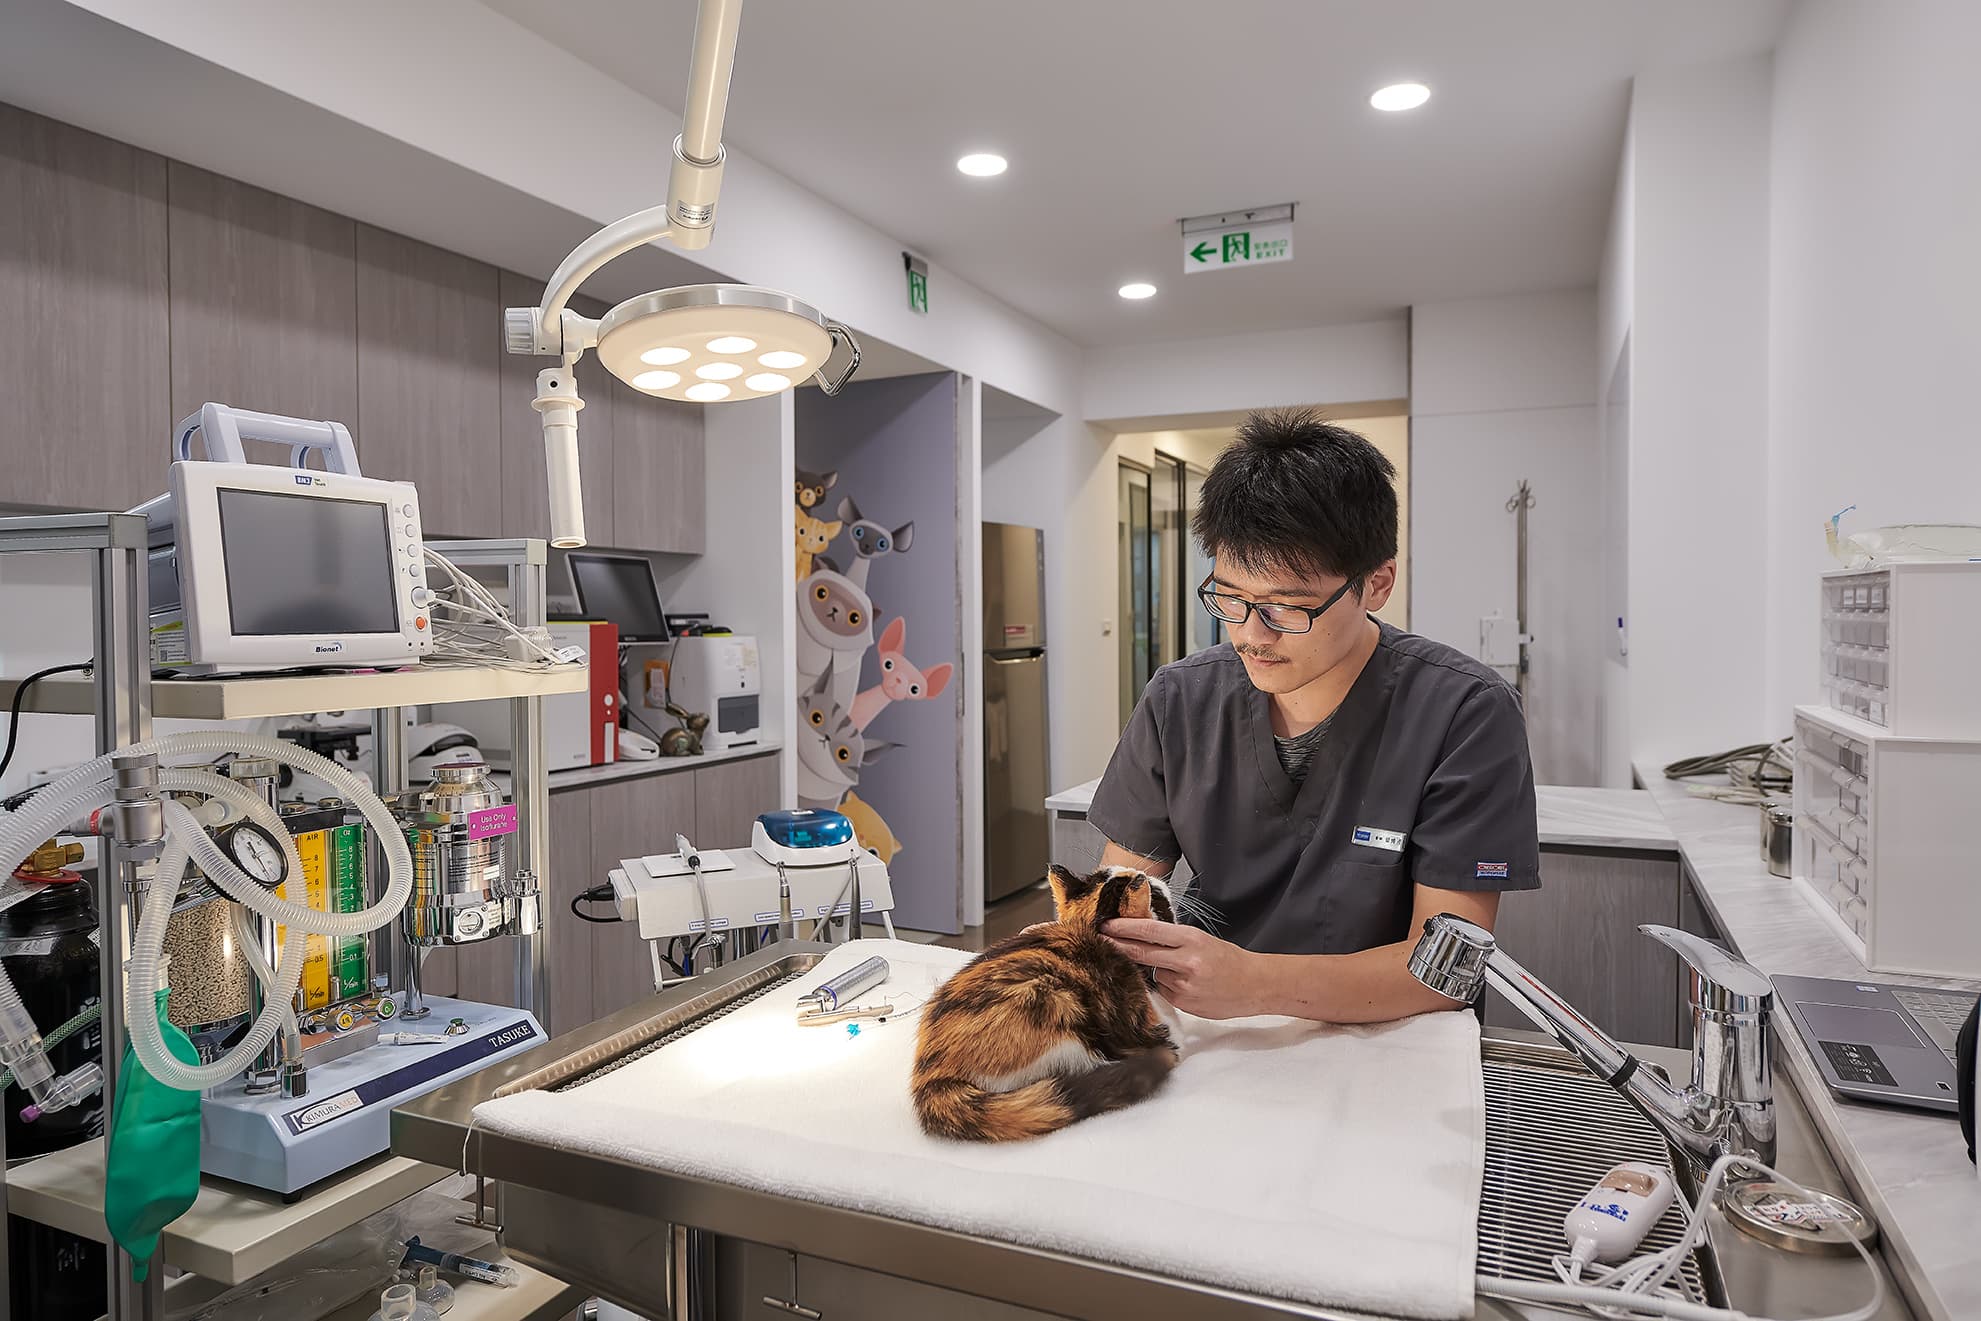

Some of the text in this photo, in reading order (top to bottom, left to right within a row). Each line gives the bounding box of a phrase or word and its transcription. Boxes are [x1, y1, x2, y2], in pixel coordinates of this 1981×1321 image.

[481, 813, 507, 824] Use Only
[489, 1025, 531, 1048] TASUKE
